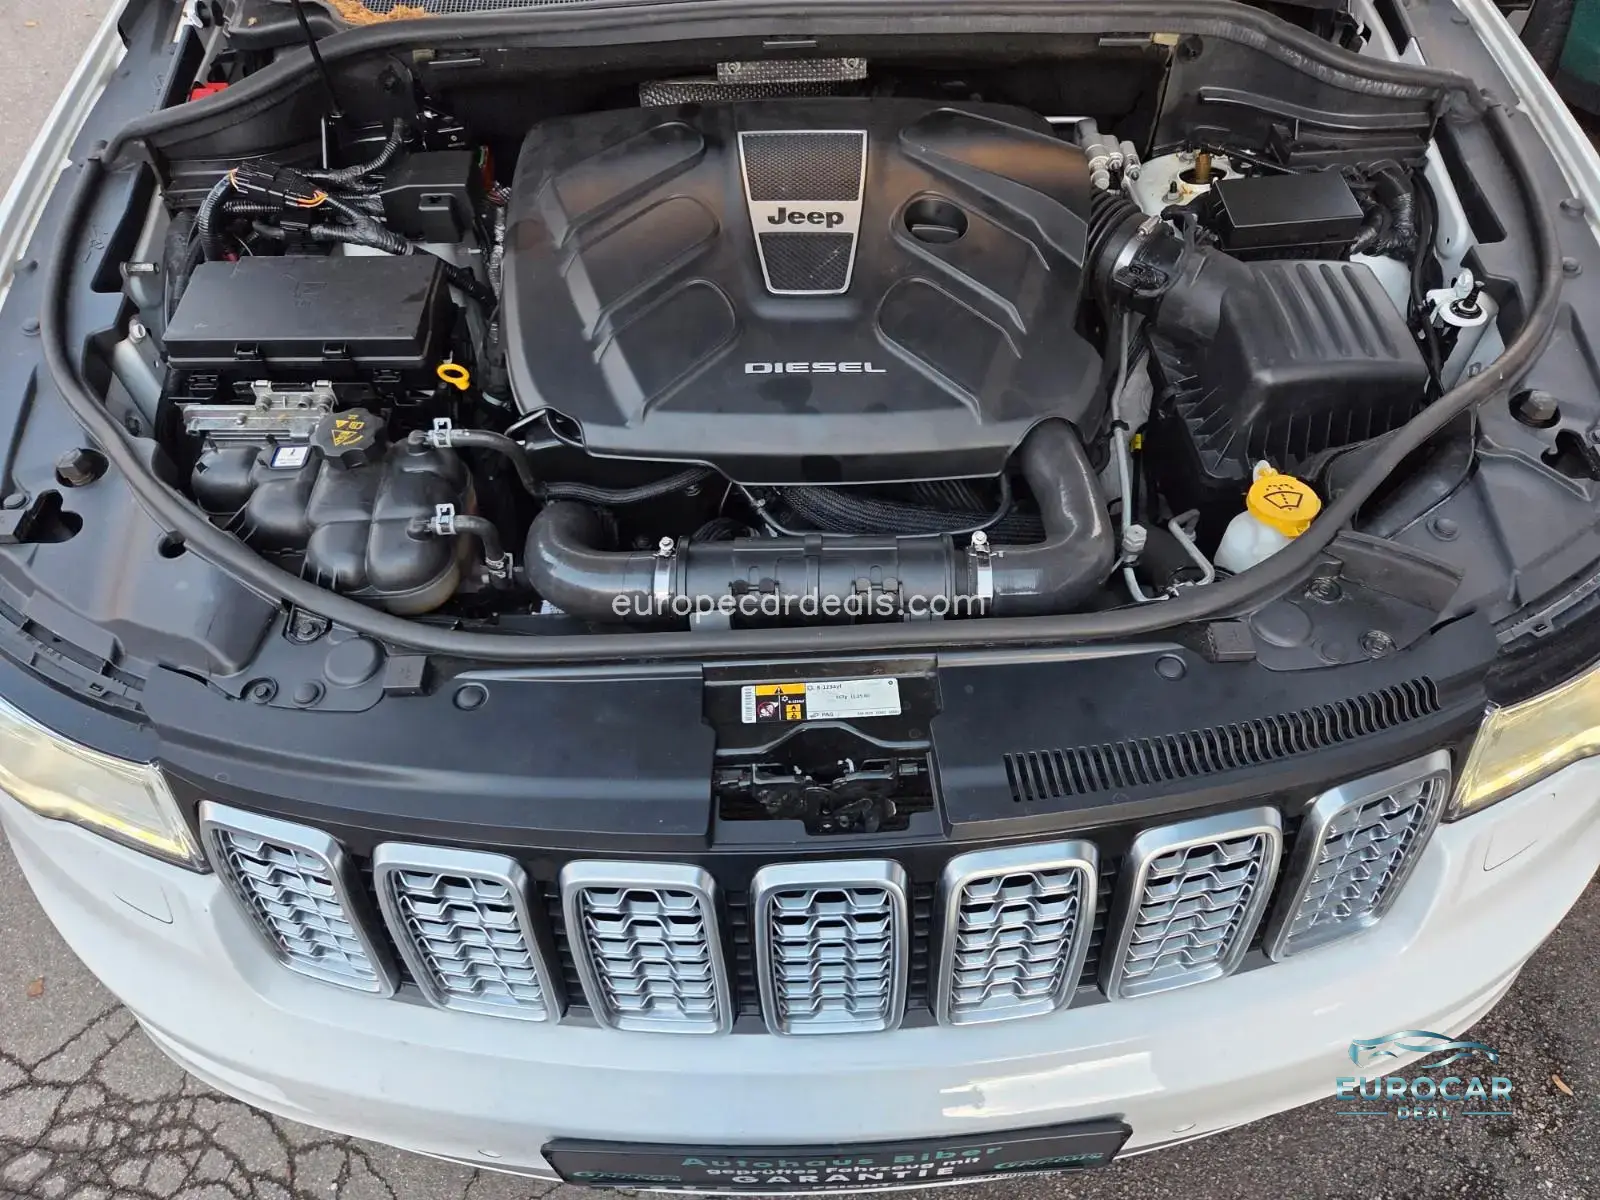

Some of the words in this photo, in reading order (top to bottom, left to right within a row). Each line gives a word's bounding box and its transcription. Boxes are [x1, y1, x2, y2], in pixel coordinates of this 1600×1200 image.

[767, 207, 844, 228] Jeep
[745, 362, 887, 374] DIESEL
[681, 1157, 873, 1168] Autohaus
[894, 1147, 1003, 1164] Biber
[825, 1162, 934, 1174] Fahrzeug
[943, 1157, 981, 1166] mit
[732, 1166, 955, 1184] GARANTIE
